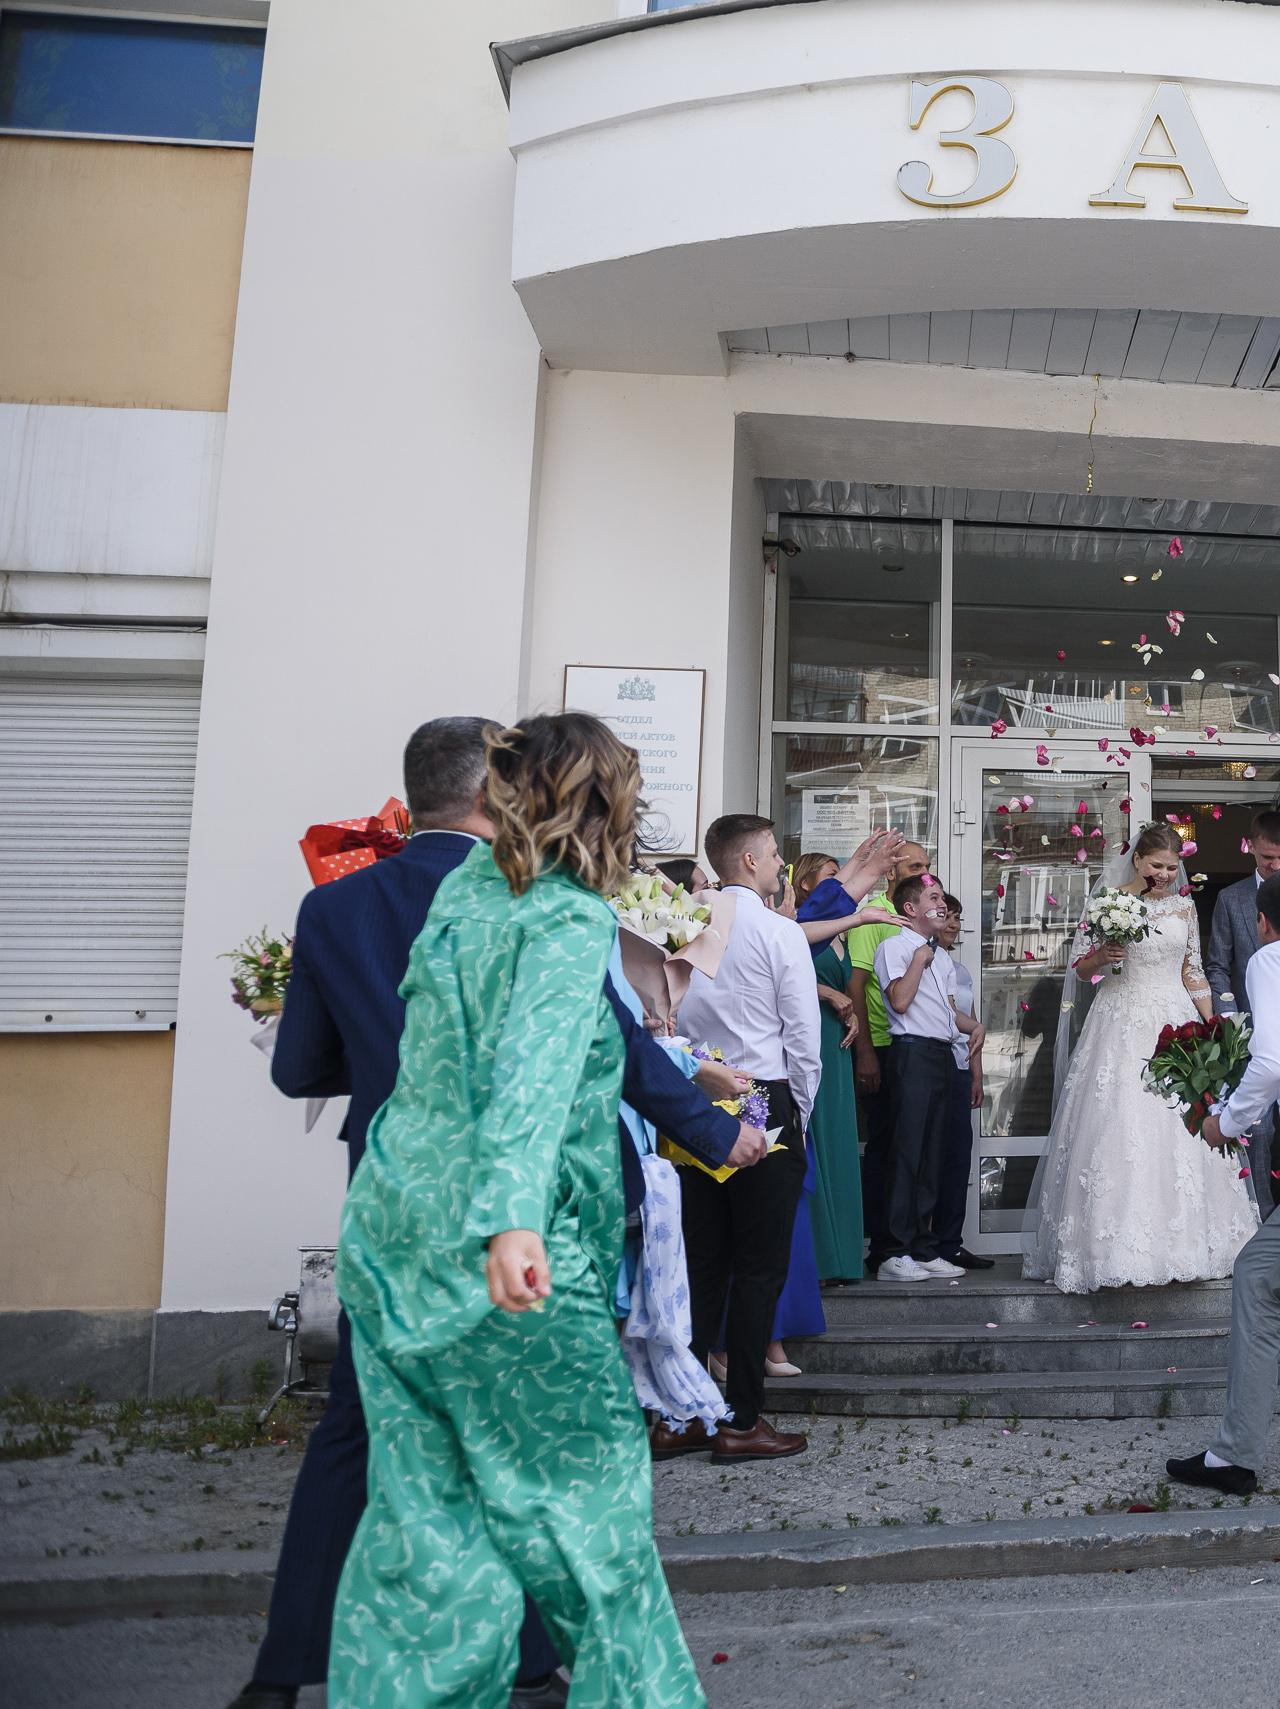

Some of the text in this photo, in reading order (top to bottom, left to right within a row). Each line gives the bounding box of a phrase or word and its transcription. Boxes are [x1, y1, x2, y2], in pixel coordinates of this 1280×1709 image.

[616, 715, 653, 725] ОТДЕЛ
[616, 732, 676, 742] ИСИ АКТОВ
